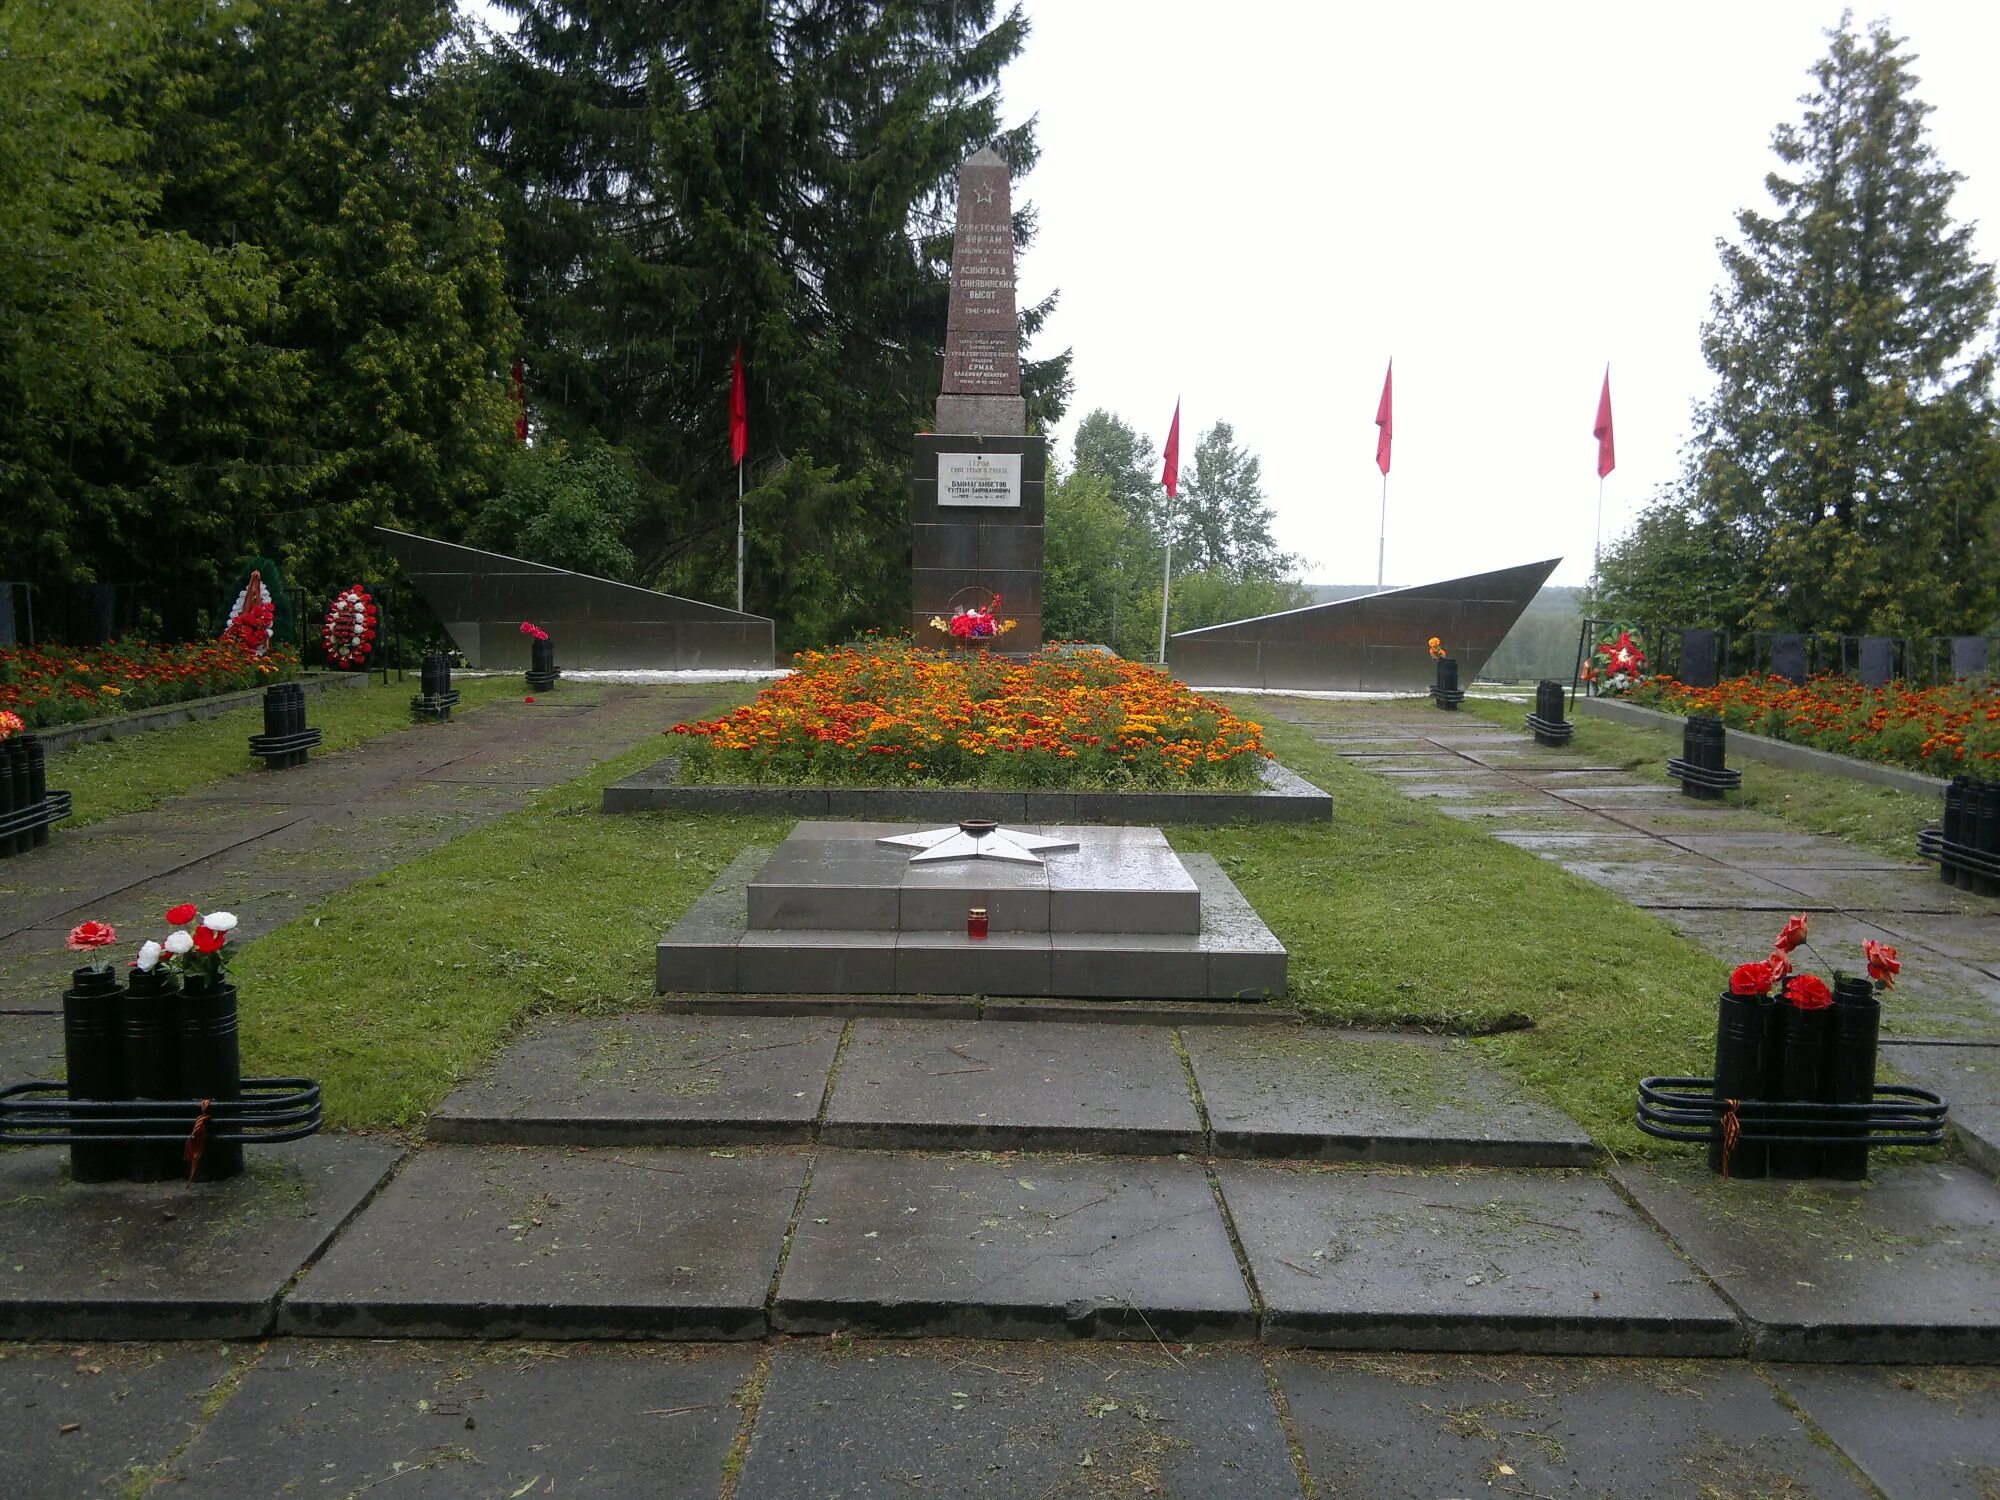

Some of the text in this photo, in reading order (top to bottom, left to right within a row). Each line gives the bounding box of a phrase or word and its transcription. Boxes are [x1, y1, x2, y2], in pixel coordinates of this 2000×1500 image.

[959, 223, 1009, 233] СОВЕТСКИМ
[960, 266, 1006, 275] ЛЕНИНГРАД
[960, 279, 1013, 288] СИНЯВИНСКИХ
[969, 290, 996, 299] ВЫСОТ
[965, 307, 1000, 315] 1941-1944
